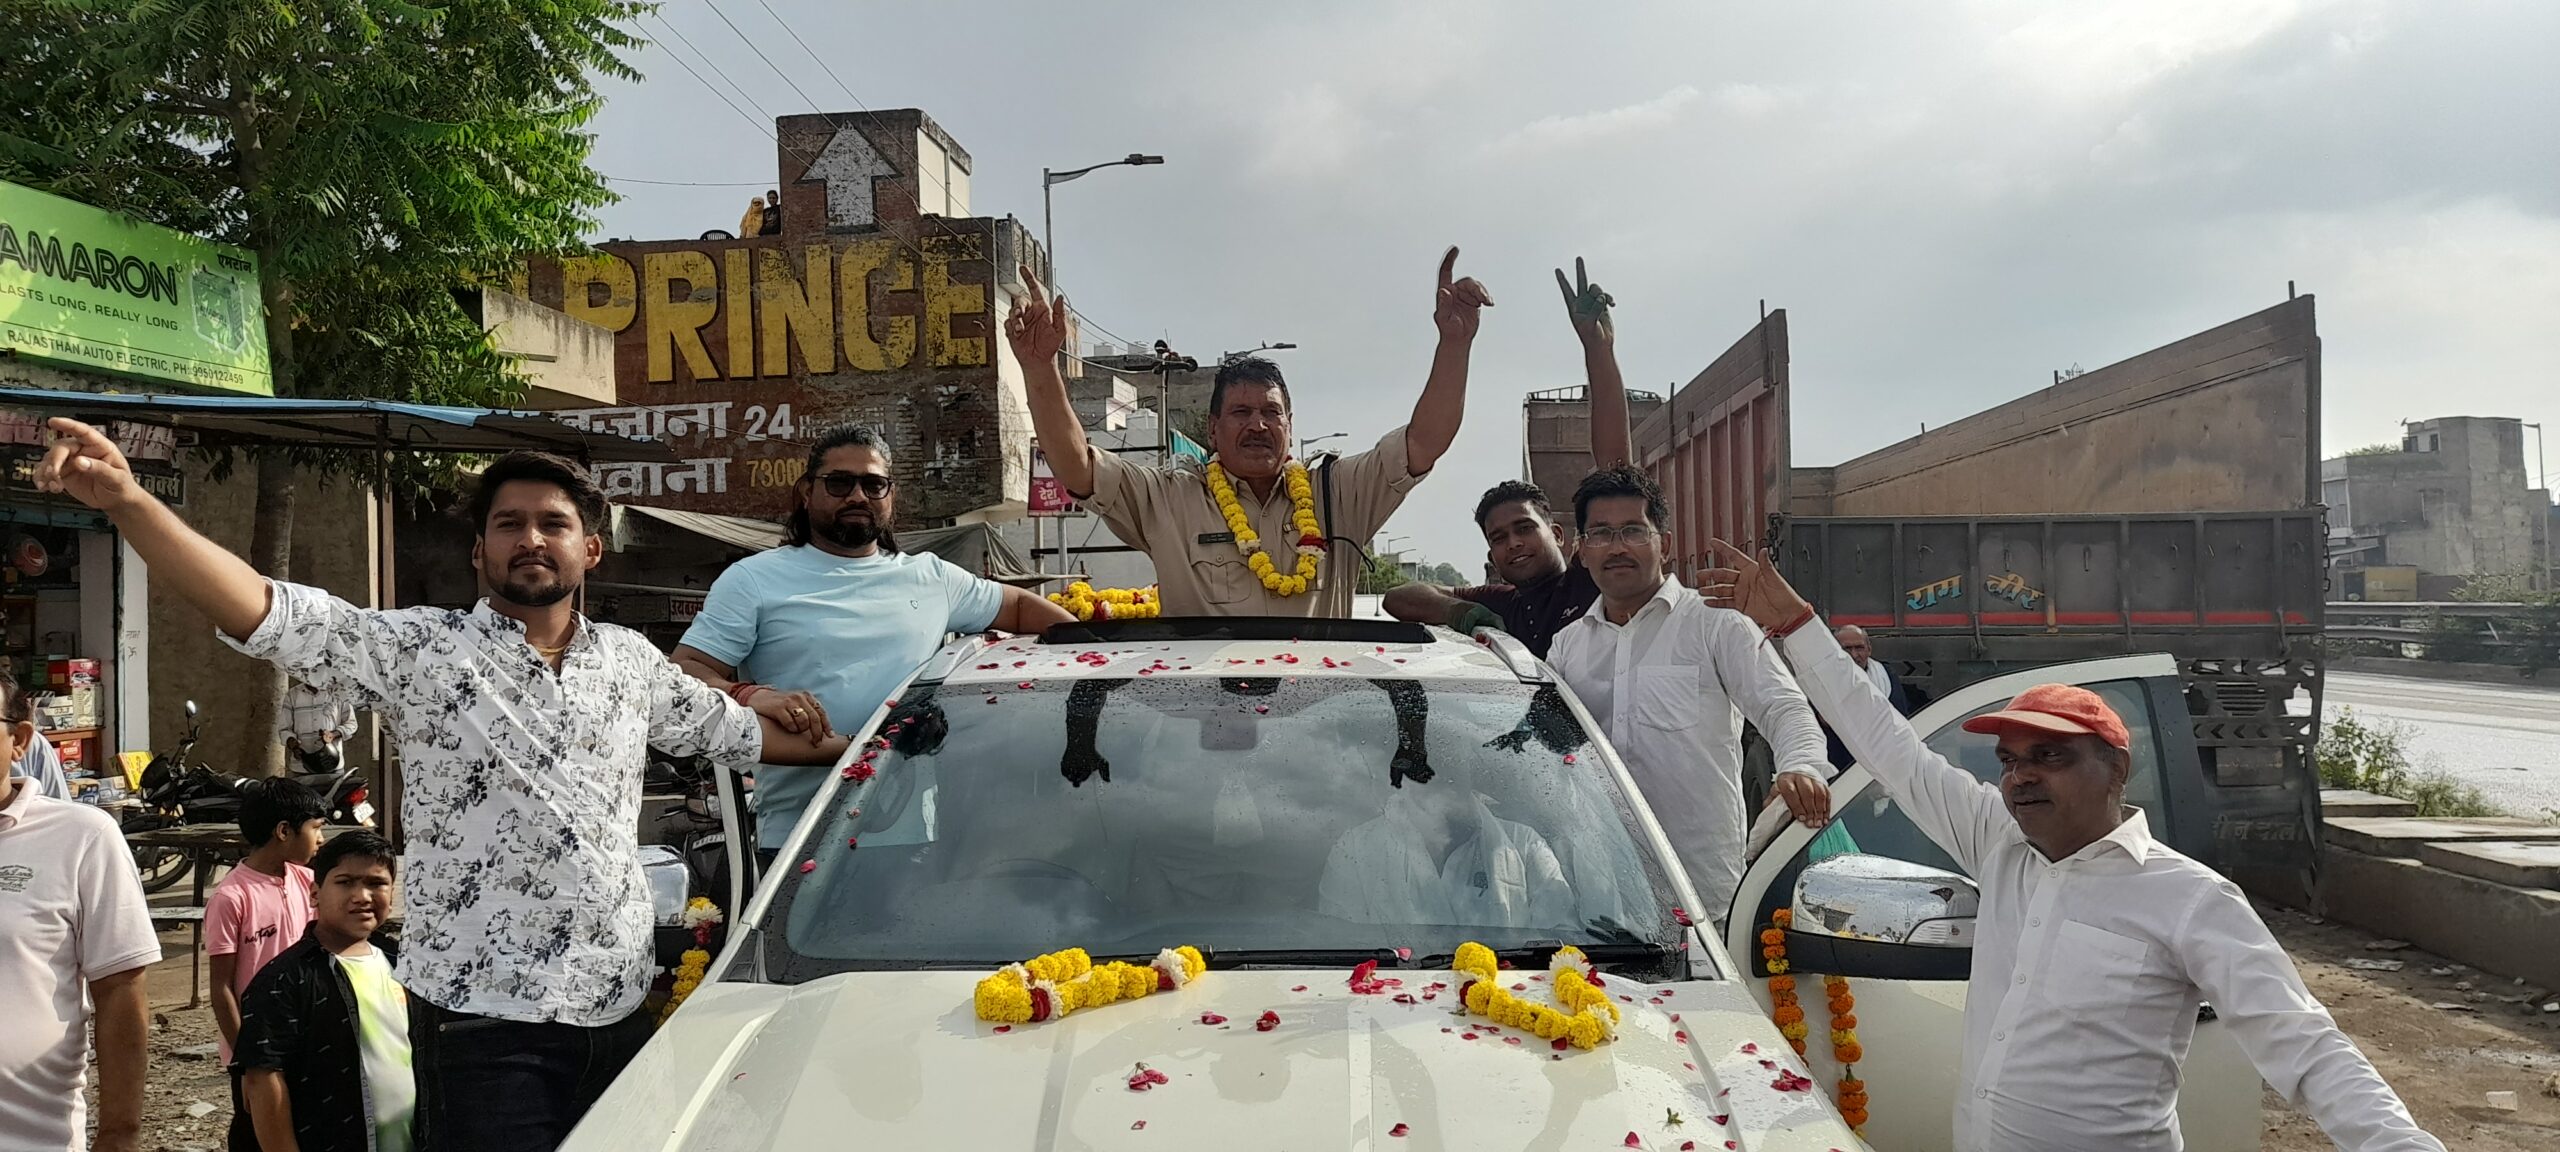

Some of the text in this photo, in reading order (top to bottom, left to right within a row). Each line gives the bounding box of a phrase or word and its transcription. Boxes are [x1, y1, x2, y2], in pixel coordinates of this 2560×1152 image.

[0, 222, 178, 306] AMARON
[0, 282, 44, 302] LASTS
[94, 304, 141, 323] REALLY
[145, 315, 182, 332] LONG.
[563, 232, 987, 383] PRINCE
[7, 329, 81, 355] RAJASTHAN
[83, 345, 114, 361] AUTO
[116, 351, 171, 374] ELECTRIC,
[743, 402, 796, 442] 24
[1905, 573, 1964, 611] राम
